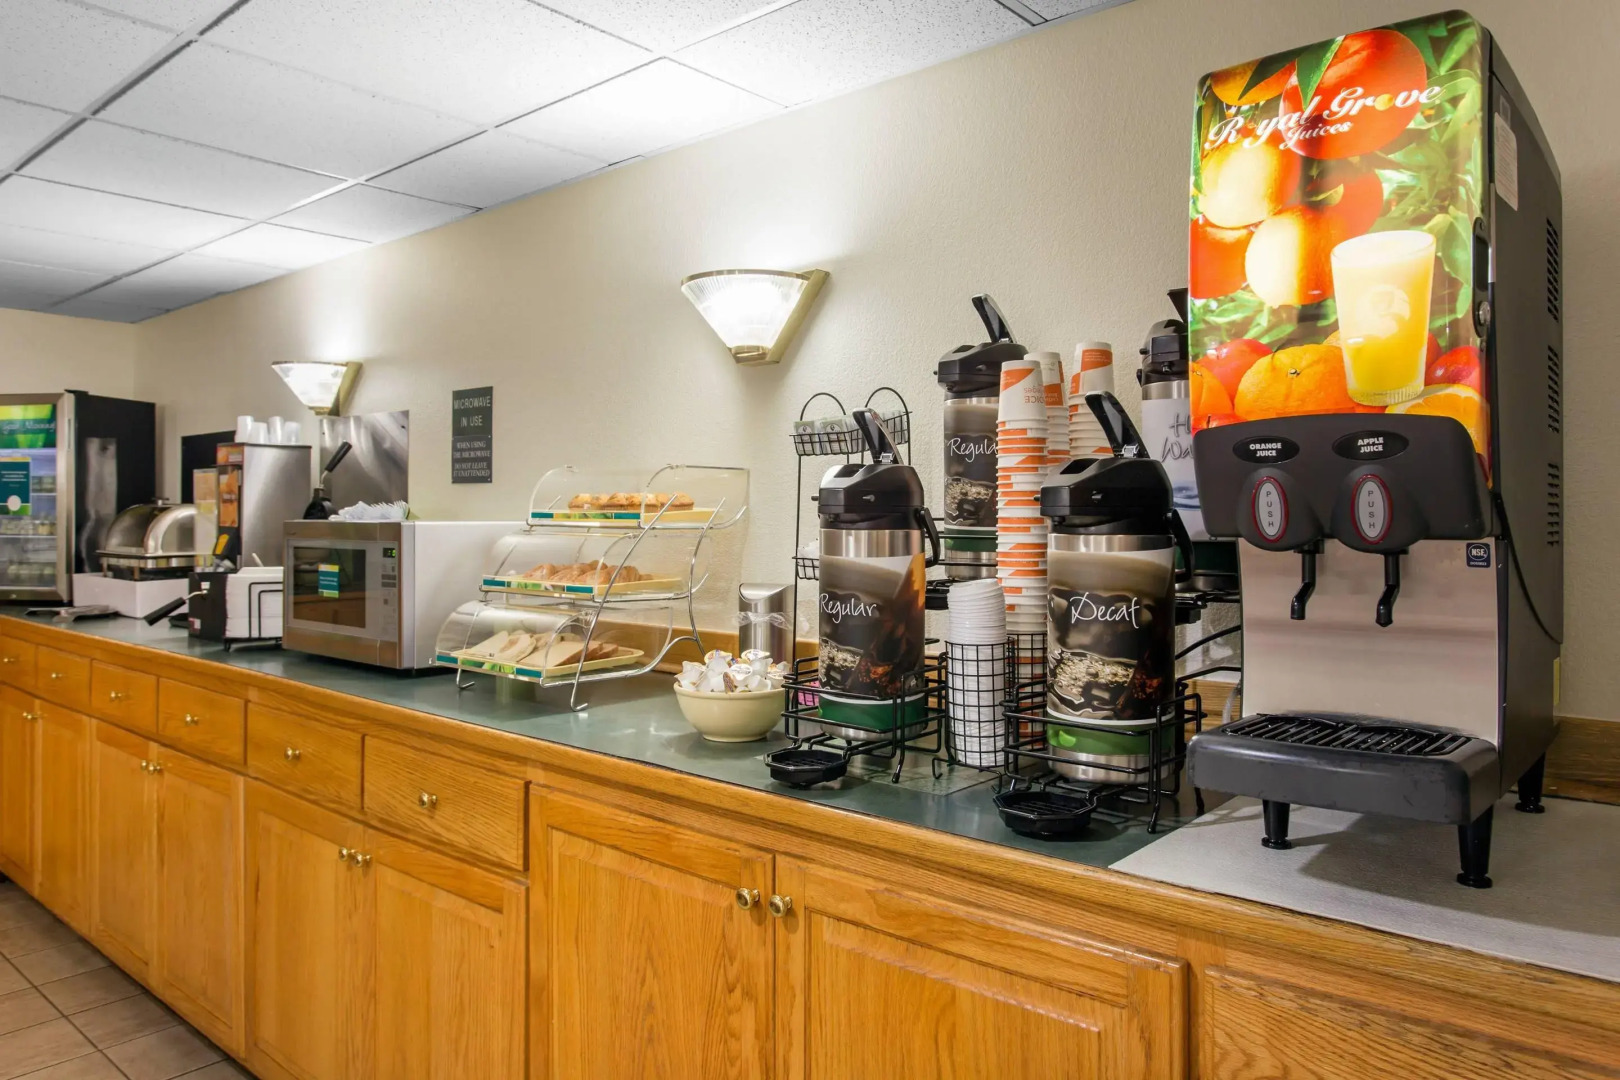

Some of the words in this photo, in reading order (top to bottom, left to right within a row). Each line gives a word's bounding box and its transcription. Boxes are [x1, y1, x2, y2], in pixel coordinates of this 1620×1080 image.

[1322, 86, 1446, 121] Grove
[1279, 121, 1354, 151] Juices
[453, 396, 490, 409] MICROWAVE
[460, 416, 468, 427] IN
[470, 415, 483, 427] USE
[947, 437, 998, 463] Regula
[1249, 442, 1282, 451] ORANGE
[1357, 436, 1384, 446] APPLE
[1360, 444, 1384, 453] JUICE
[1265, 490, 1275, 528] PUSH
[1366, 490, 1376, 529] PUSH
[819, 593, 877, 624] Regular
[1069, 591, 1140, 629] Decaf
